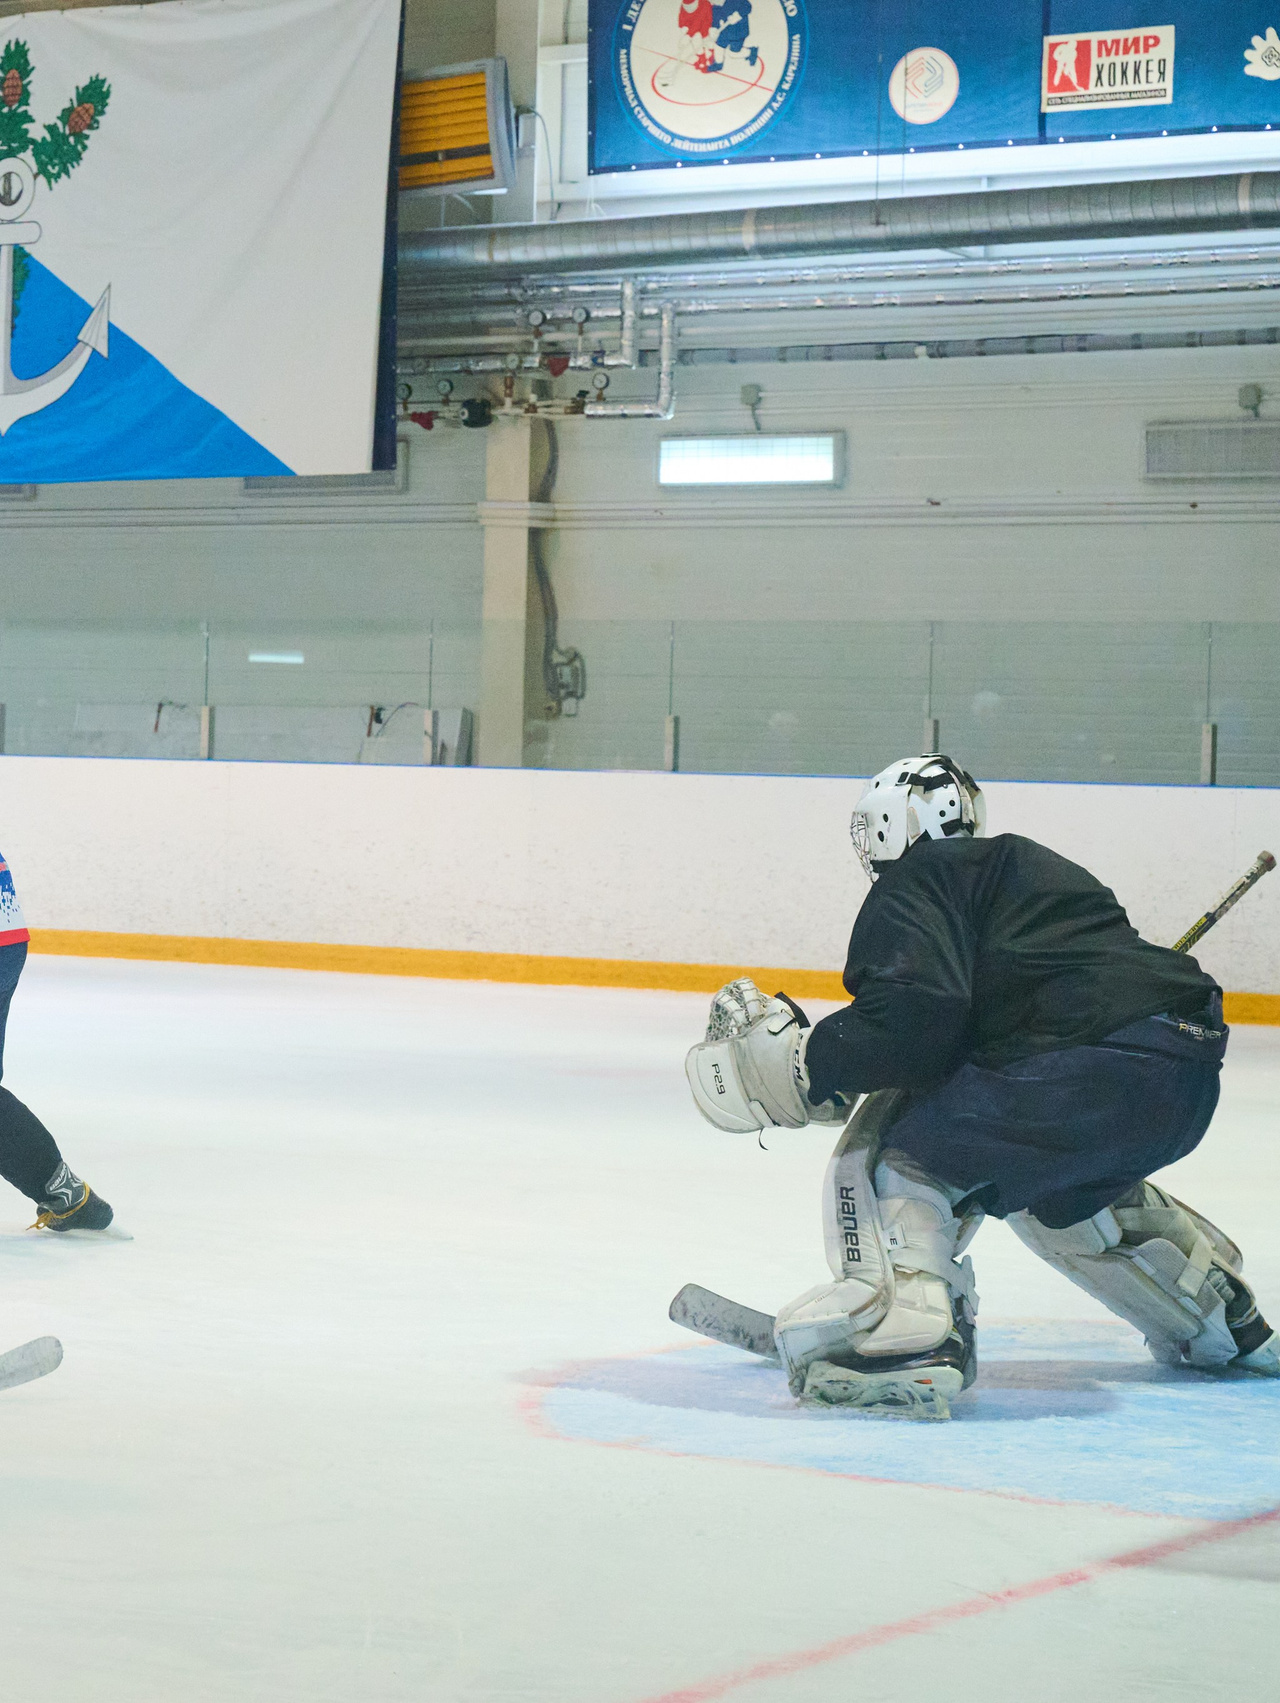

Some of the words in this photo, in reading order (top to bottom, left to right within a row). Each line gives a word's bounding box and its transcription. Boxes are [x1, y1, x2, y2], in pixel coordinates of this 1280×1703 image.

[1097, 34, 1161, 58] МИР
[1095, 58, 1167, 88] ХОККЕЯ
[1178, 1022, 1222, 1039] PREMIER
